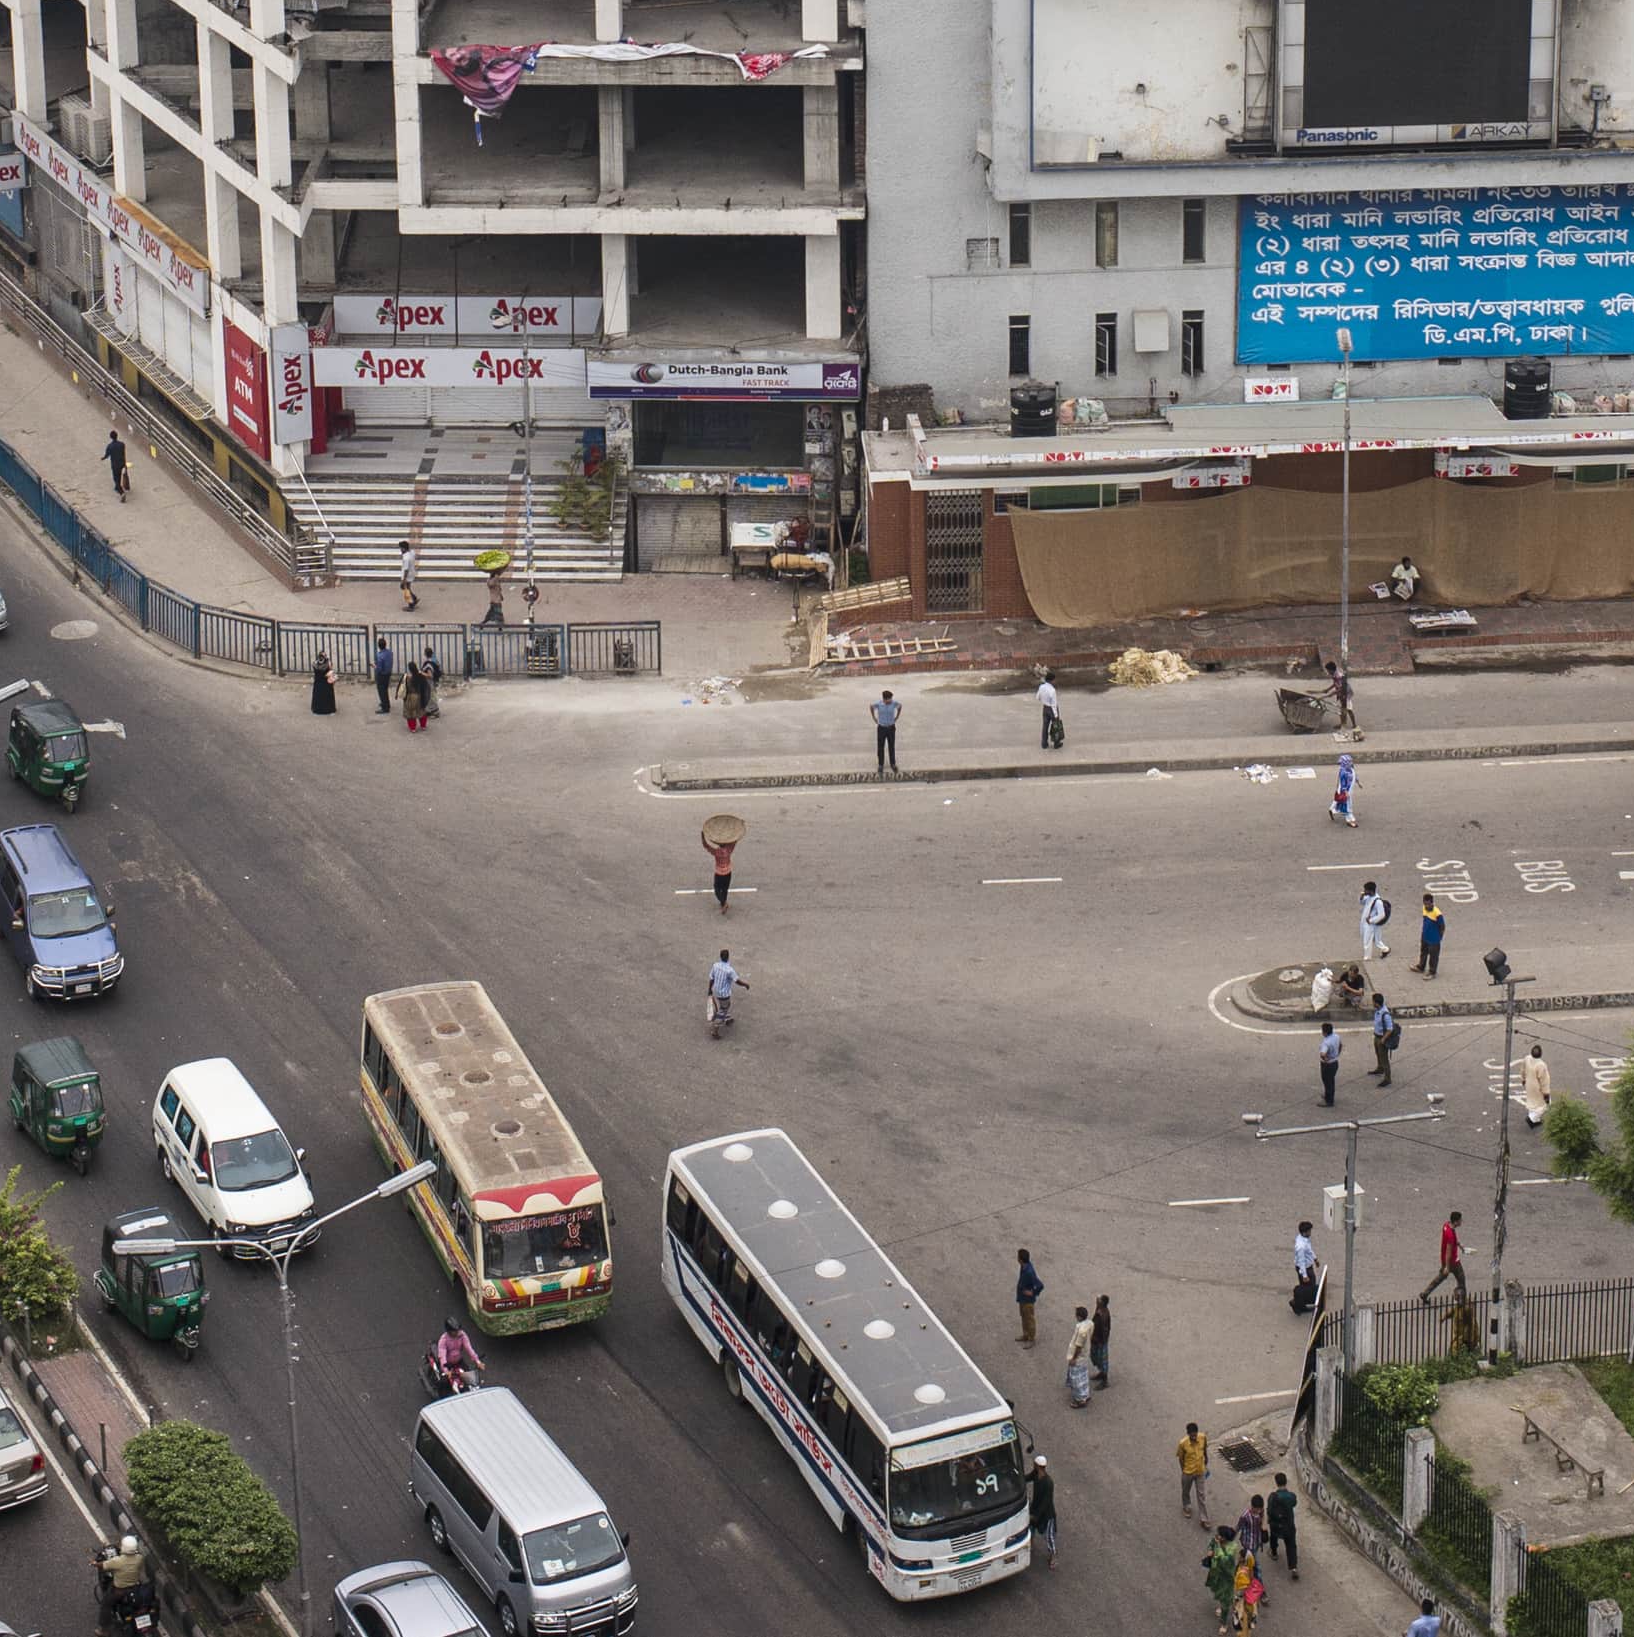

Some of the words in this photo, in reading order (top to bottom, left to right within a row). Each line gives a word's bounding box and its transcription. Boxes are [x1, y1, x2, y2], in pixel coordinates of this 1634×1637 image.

[19, 122, 41, 161] Apex
[1296, 127, 1378, 143] Panasonic
[1468, 123, 1533, 138] ARKAY
[48, 145, 71, 186] Apex
[76, 169, 100, 209] Apex
[106, 194, 131, 236] Apex
[1255, 210, 1282, 231] ইং
[1292, 212, 1331, 230] ধারা
[1341, 207, 1382, 227] মানি
[1393, 205, 1464, 226] লন্ডারিং
[1472, 203, 1555, 225] প্রতিরোধ
[1565, 202, 1620, 222] আইন
[137, 223, 162, 263] Apex
[1255, 235, 1291, 257] (২)
[1301, 234, 1341, 253] ধারা
[1350, 233, 1411, 251] তৎসহ
[1418, 229, 1460, 249] মানি
[1469, 227, 1539, 247] লন্ডারিং
[1546, 225, 1629, 247] প্রতিরোধ
[169, 250, 194, 292] Apex
[1254, 260, 1286, 276] এর
[1294, 260, 1309, 275] ৪
[1319, 257, 1354, 278] (২)
[1364, 255, 1400, 277] (৩)
[1409, 255, 1450, 272] ধারা
[1458, 252, 1529, 271] সংক্রান্ত
[1536, 249, 1578, 269] বিজ্ঞ
[1251, 281, 1347, 301] মোতাবেক
[376, 298, 447, 332] Apex
[488, 298, 559, 332] Apex
[1251, 304, 1285, 325] এই
[1296, 303, 1380, 322] সম্পদের
[1528, 323, 1575, 342] ঢাকা
[354, 350, 427, 385] Apex
[472, 350, 545, 385] Apex
[668, 365, 754, 377] Dutch-Bangla
[757, 365, 788, 376] Bank
[233, 376, 254, 404] ATM
[278, 353, 310, 416] Apex
[742, 379, 762, 387] FAST
[763, 379, 790, 387] TRACK
[975, 1473, 1000, 1496] ১৭
